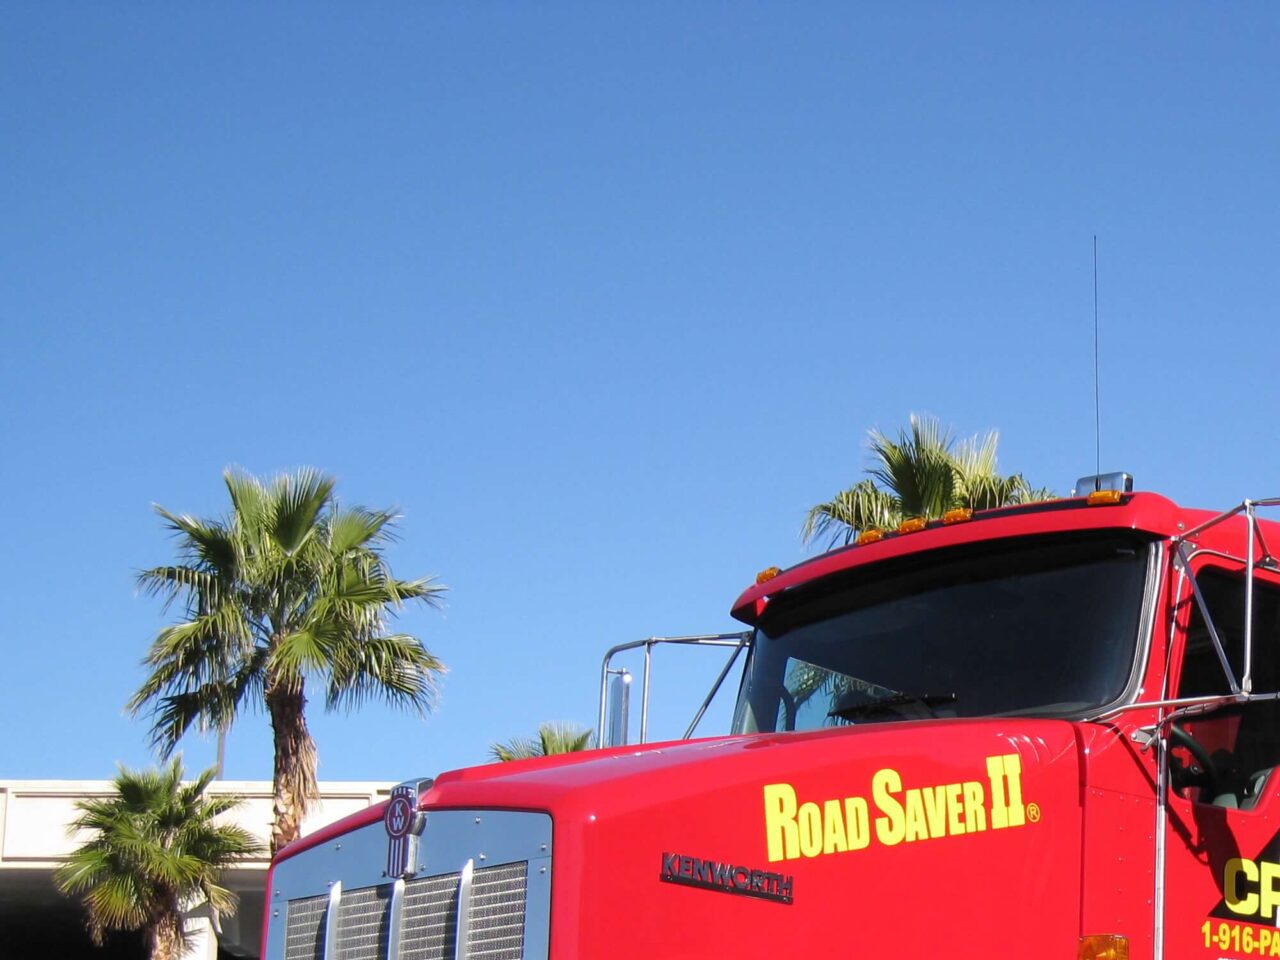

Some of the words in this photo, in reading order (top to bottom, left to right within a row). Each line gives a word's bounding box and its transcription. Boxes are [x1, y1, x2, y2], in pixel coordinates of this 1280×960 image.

[763, 783, 870, 862] ROAD
[872, 768, 986, 846] SAVER
[660, 852, 794, 898] KENWORTH
